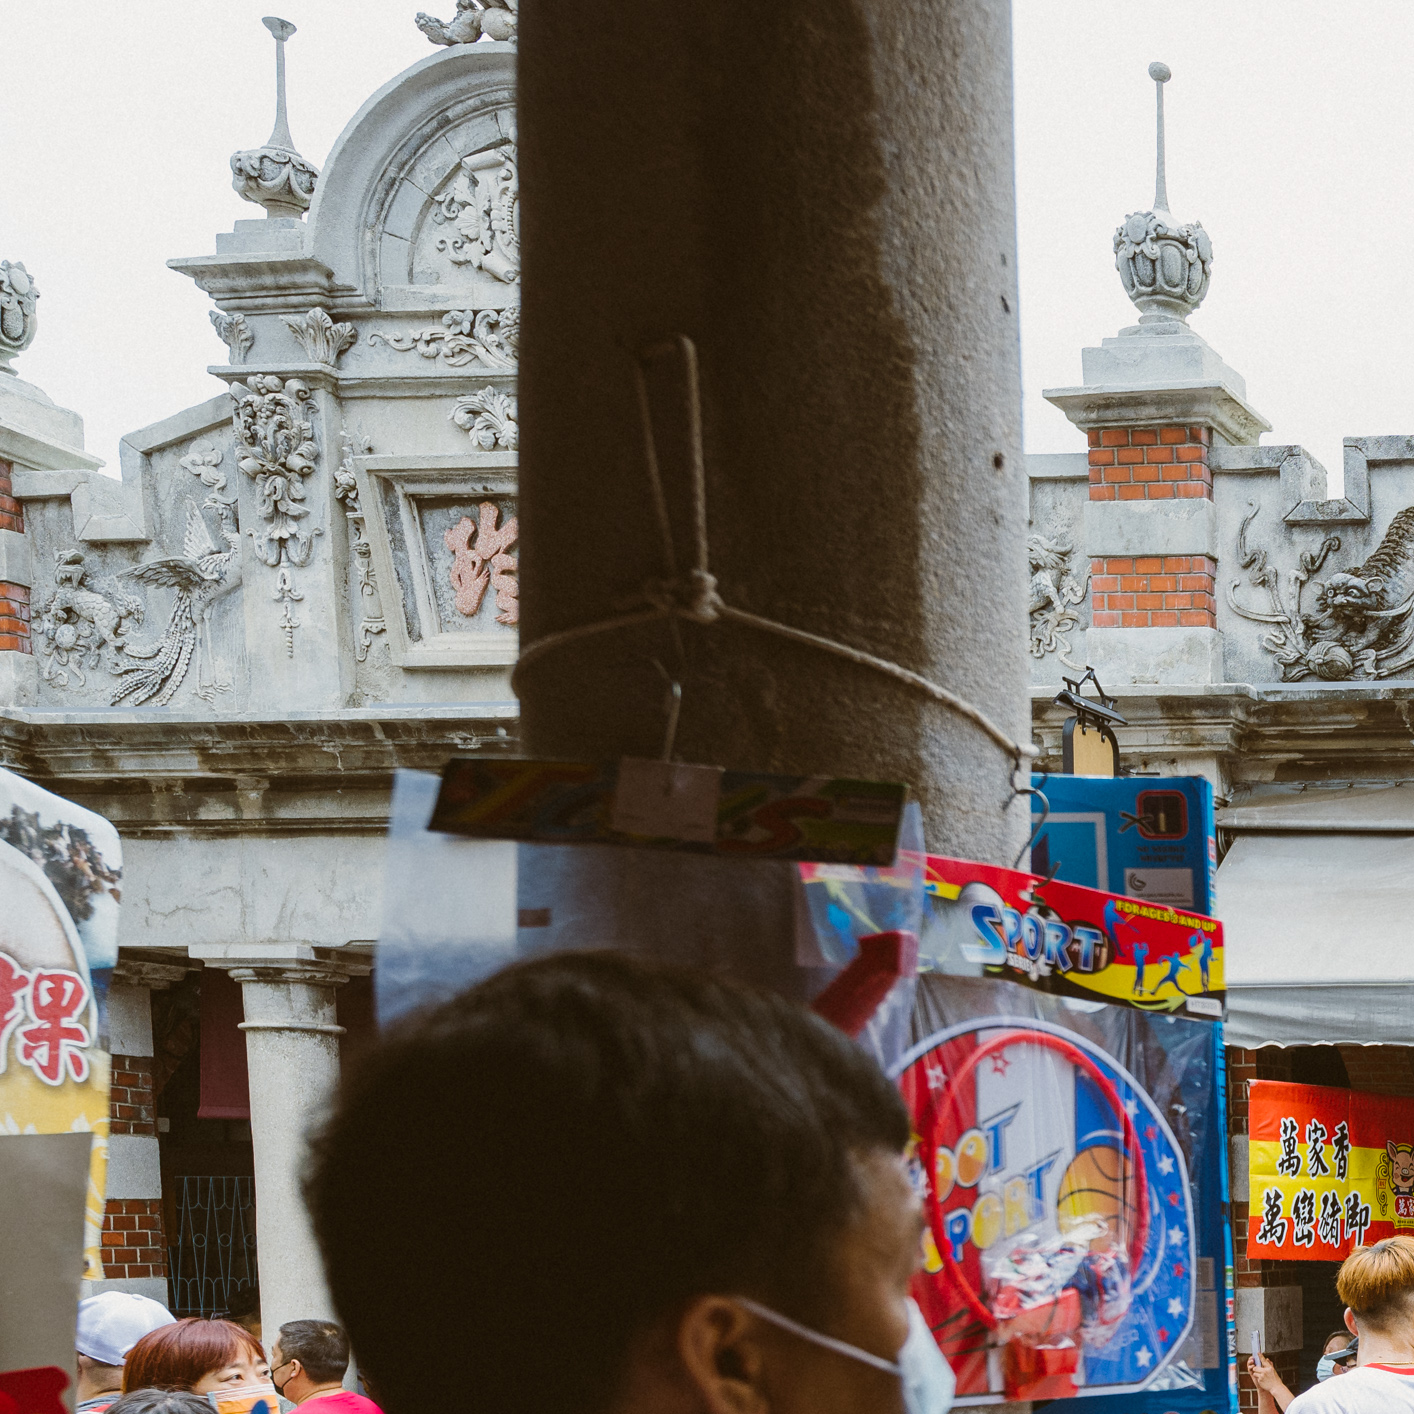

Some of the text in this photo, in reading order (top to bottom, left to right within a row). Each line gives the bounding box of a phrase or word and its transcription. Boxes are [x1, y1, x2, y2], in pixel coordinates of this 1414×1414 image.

[960, 903, 1103, 973] SPORT
[1278, 1116, 1353, 1181] 萬家香
